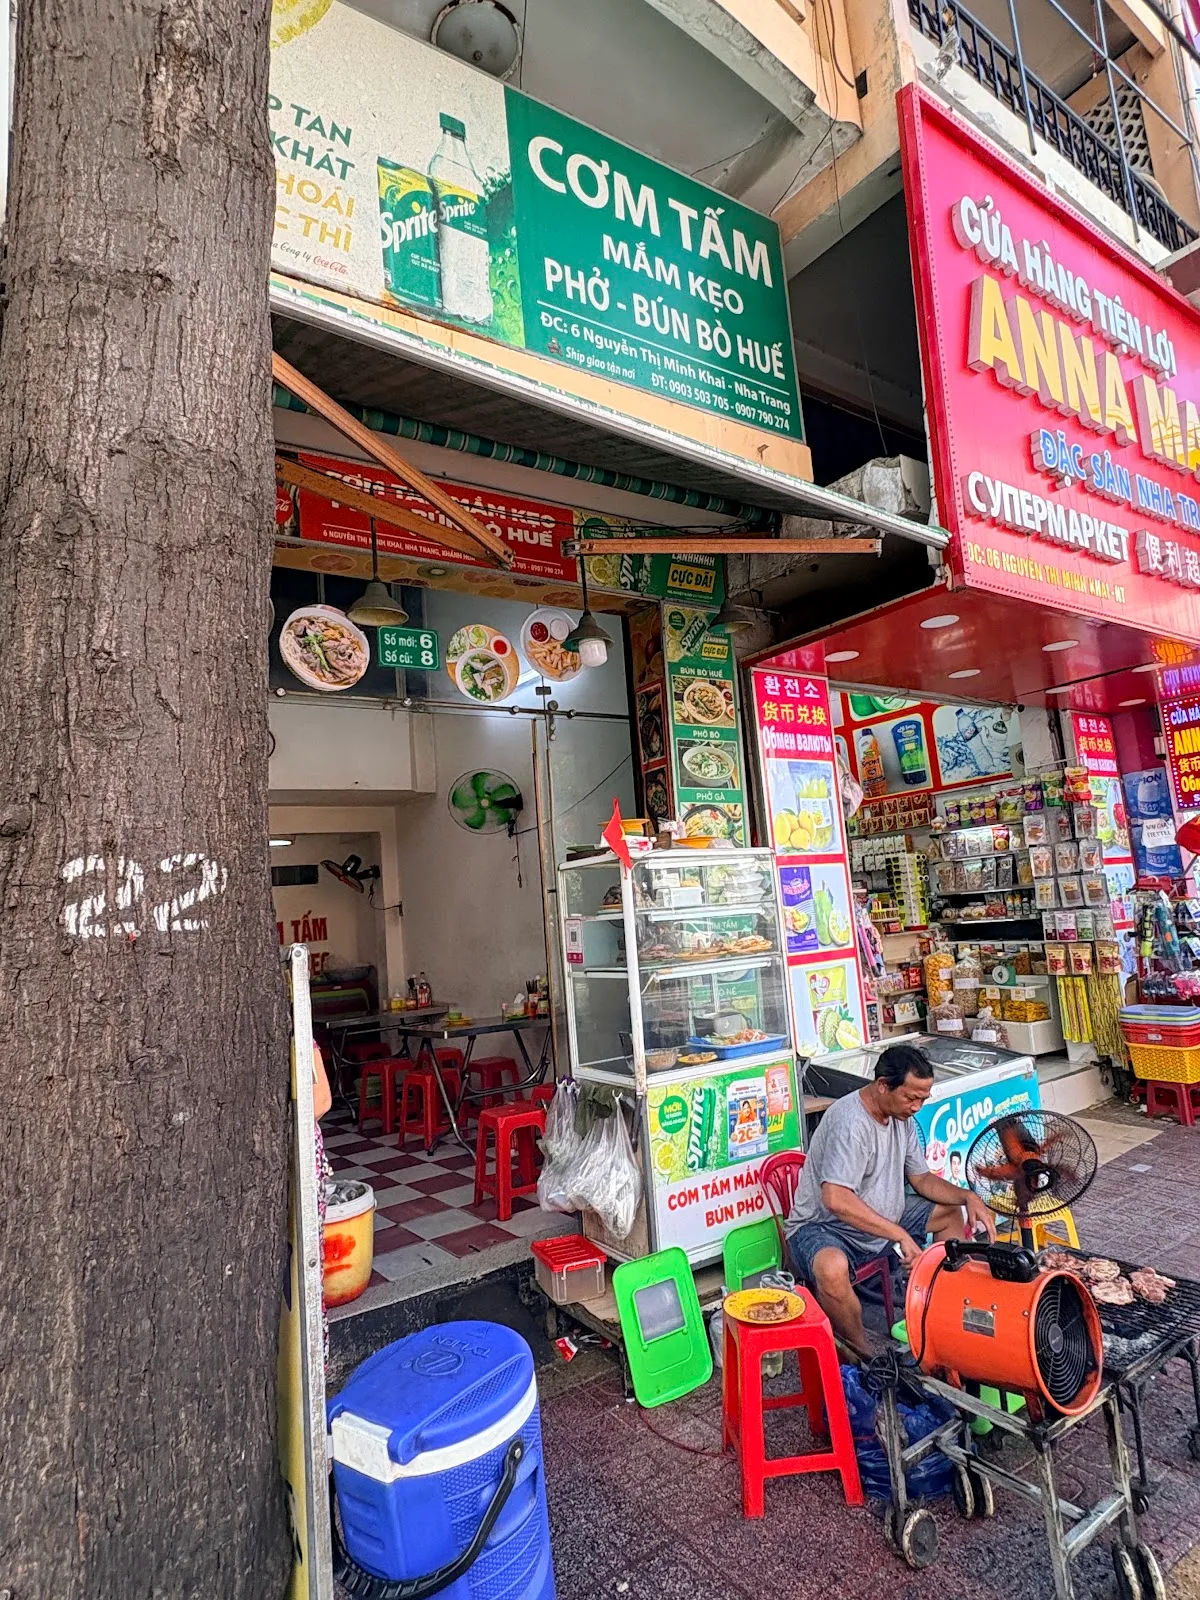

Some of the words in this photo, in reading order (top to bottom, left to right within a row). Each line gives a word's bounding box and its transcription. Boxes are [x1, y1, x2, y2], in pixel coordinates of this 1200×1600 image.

[290, 103, 352, 148] TAN
[270, 130, 355, 180] KHÁT
[380, 201, 438, 253] Sprite
[439, 197, 476, 222] Sprite
[528, 136, 660, 237] CƠM
[668, 197, 773, 288] TẤM
[298, 213, 352, 252] THÌ
[688, 271, 744, 315] KẸO
[957, 194, 1018, 274] CỬA
[1021, 238, 1091, 323] HÀNG
[1094, 292, 1142, 355] TIỆN
[1144, 323, 1177, 381] LỢI
[544, 257, 611, 312] PHỞ
[633, 293, 691, 345] BÚN
[696, 317, 732, 359] BÒ
[736, 334, 786, 380] HUẾ
[540, 312, 569, 334] ĐC:
[570, 323, 581, 338] 6
[640, 347, 663, 370] Thị
[664, 357, 696, 379] Minh
[698, 369, 726, 390] Khai
[734, 381, 758, 400] Nha
[759, 391, 790, 415] Trang
[566, 346, 585, 364] Ship
[587, 355, 606, 369] giao
[607, 361, 621, 376] tận
[622, 367, 636, 380] nơi
[974, 273, 1138, 443] ANNA
[651, 372, 668, 390] ĐT:
[668, 379, 692, 398] 0903
[694, 389, 712, 405] 503
[712, 394, 729, 411] 705
[735, 402, 756, 420] 0907
[757, 409, 774, 426] 790
[774, 415, 790, 431] 274
[1040, 429, 1088, 487] ĐẶC
[1091, 449, 1132, 501] SẢN
[1136, 474, 1177, 521] NHA
[966, 471, 1129, 562] СУПЕРМАРКЕТ
[507, 529, 553, 548] HUẾ
[986, 547, 1001, 570] 06
[671, 569, 694, 586] CỰC
[694, 571, 713, 588] ĐÃ!
[384, 632, 397, 646] Số
[399, 636, 417, 648] mới:
[420, 634, 433, 649] 6
[385, 650, 397, 663] Số
[399, 653, 413, 664] cũ:
[421, 650, 434, 665] 8
[680, 666, 695, 676] BÚN
[697, 668, 708, 677] BÒ
[762, 700, 828, 727] 货币兑换
[1170, 706, 1188, 725] CỬA
[762, 725, 796, 751] Обмен
[796, 733, 833, 753] валюты
[696, 791, 713, 801] PHỞ
[714, 792, 725, 801] GÀ
[291, 910, 328, 943] TẤM
[688, 1088, 704, 1170] Sprite
[929, 1097, 994, 1144] Celano
[668, 1187, 699, 1211] CƠM
[702, 1176, 731, 1200] TẤM
[705, 1204, 734, 1227] BÚN
[737, 1191, 764, 1217] PHỞ
